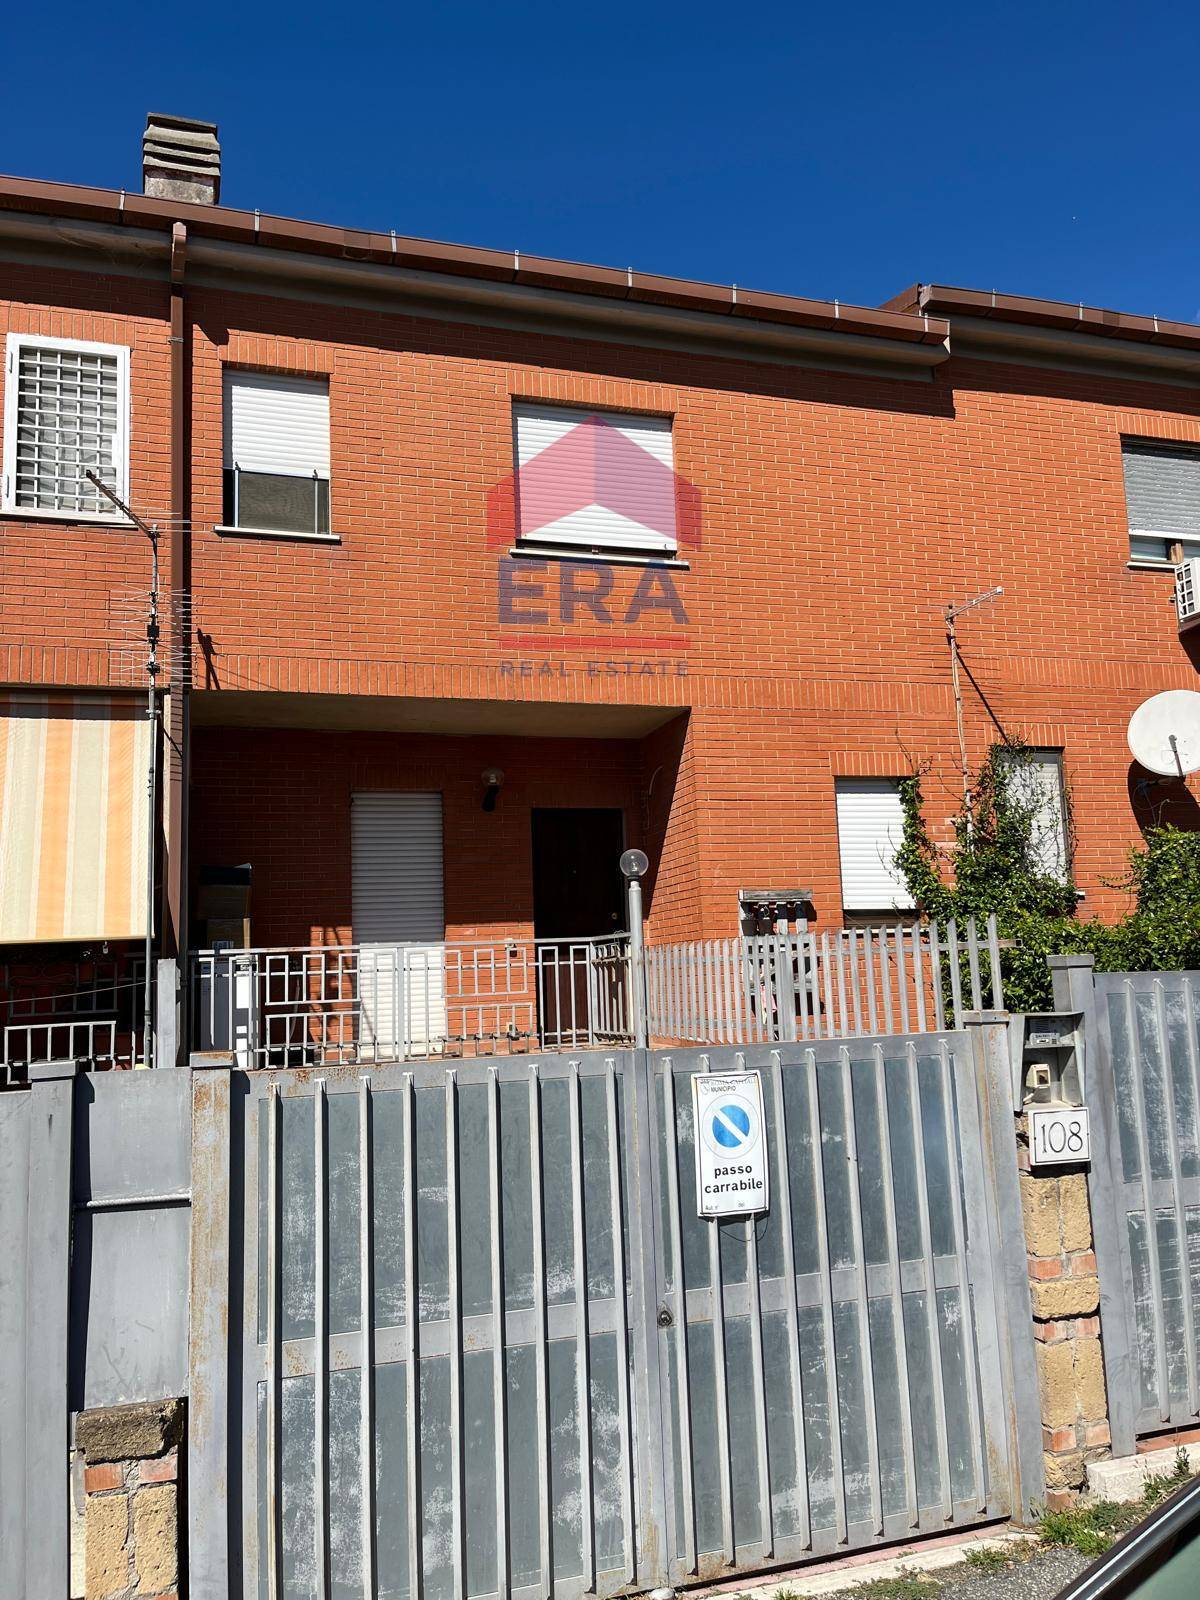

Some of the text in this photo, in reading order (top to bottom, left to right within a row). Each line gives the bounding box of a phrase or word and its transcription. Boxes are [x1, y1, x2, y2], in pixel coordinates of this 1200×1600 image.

[710, 1084, 737, 1093] MUNICIPIO
[1041, 1121, 1083, 1154] 108
[714, 1165, 752, 1179] passo
[704, 1177, 763, 1193] carrabile
